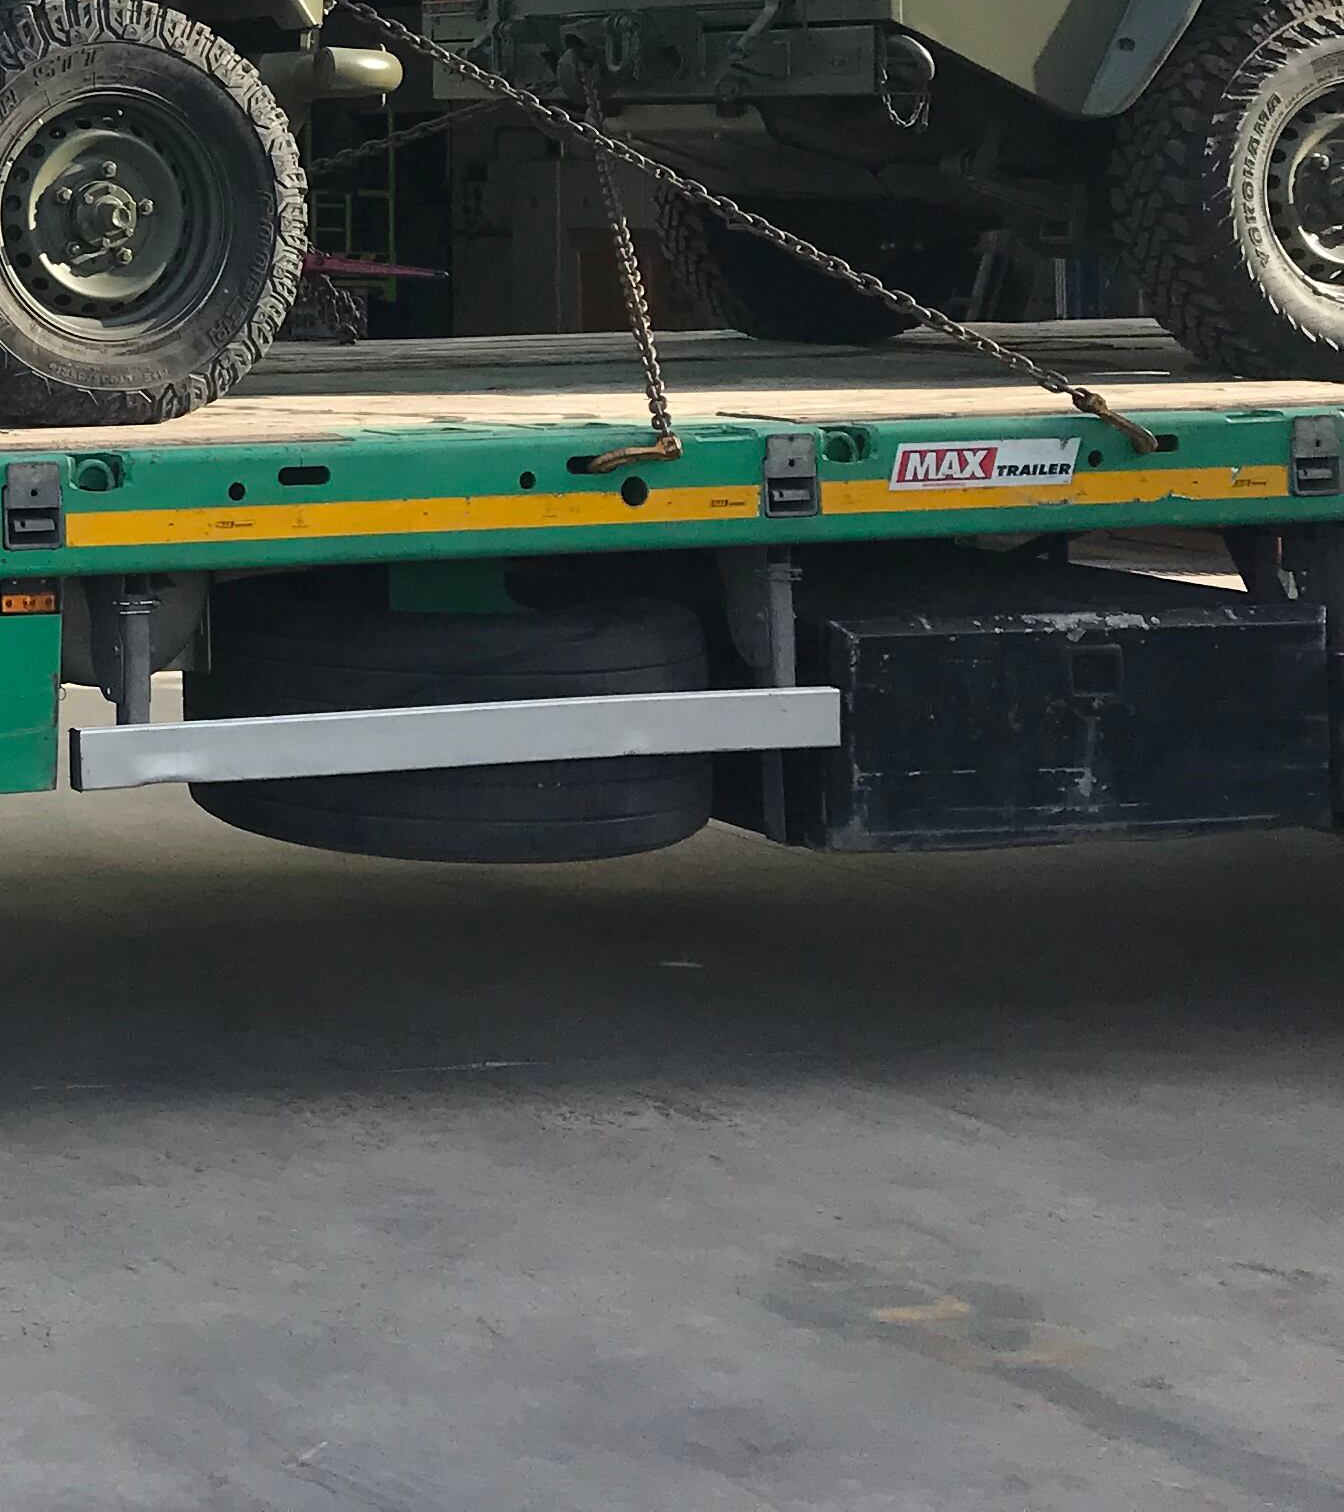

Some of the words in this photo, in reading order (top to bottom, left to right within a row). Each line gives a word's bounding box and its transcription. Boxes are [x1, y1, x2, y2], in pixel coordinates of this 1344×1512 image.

[1240, 92, 1281, 269] YOKOHAMA
[905, 450, 988, 481] MAX
[997, 463, 1072, 477] TRAILER
